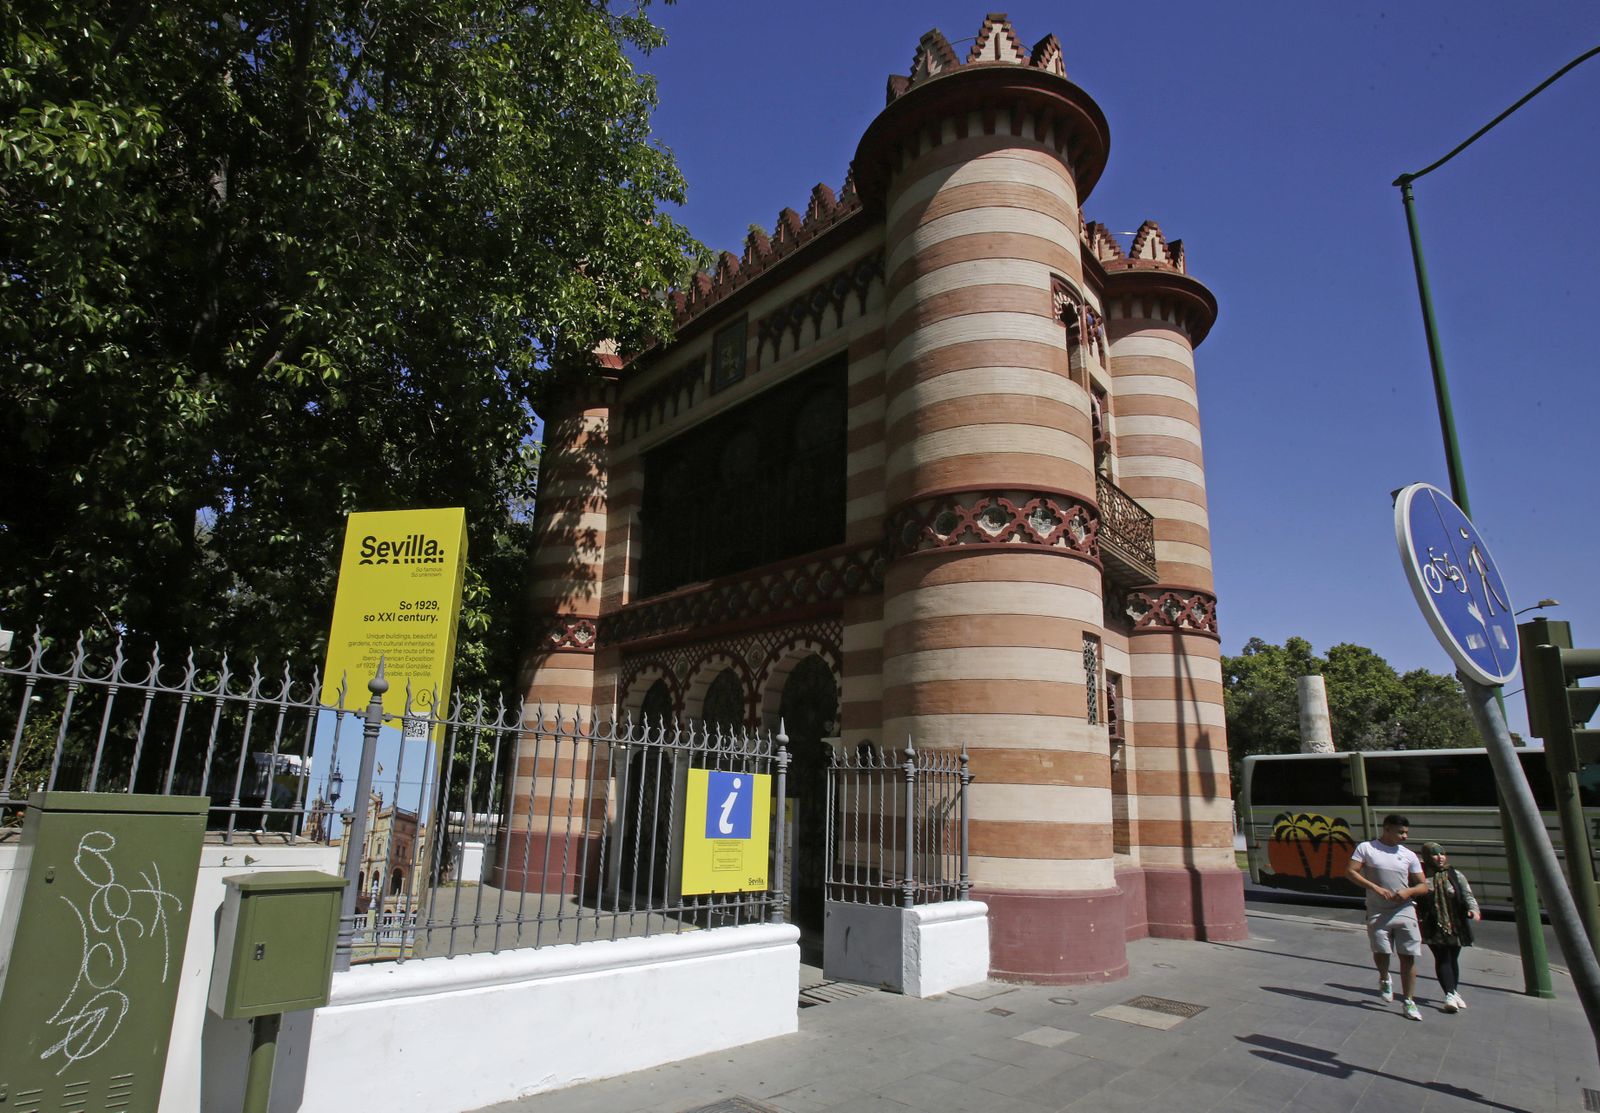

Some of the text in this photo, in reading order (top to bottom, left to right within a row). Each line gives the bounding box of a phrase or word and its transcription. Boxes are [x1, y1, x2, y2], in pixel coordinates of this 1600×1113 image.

[360, 534, 445, 558] Sevilla.
[399, 600, 440, 611] So 1929,
[363, 612, 439, 624] so XXI century.
